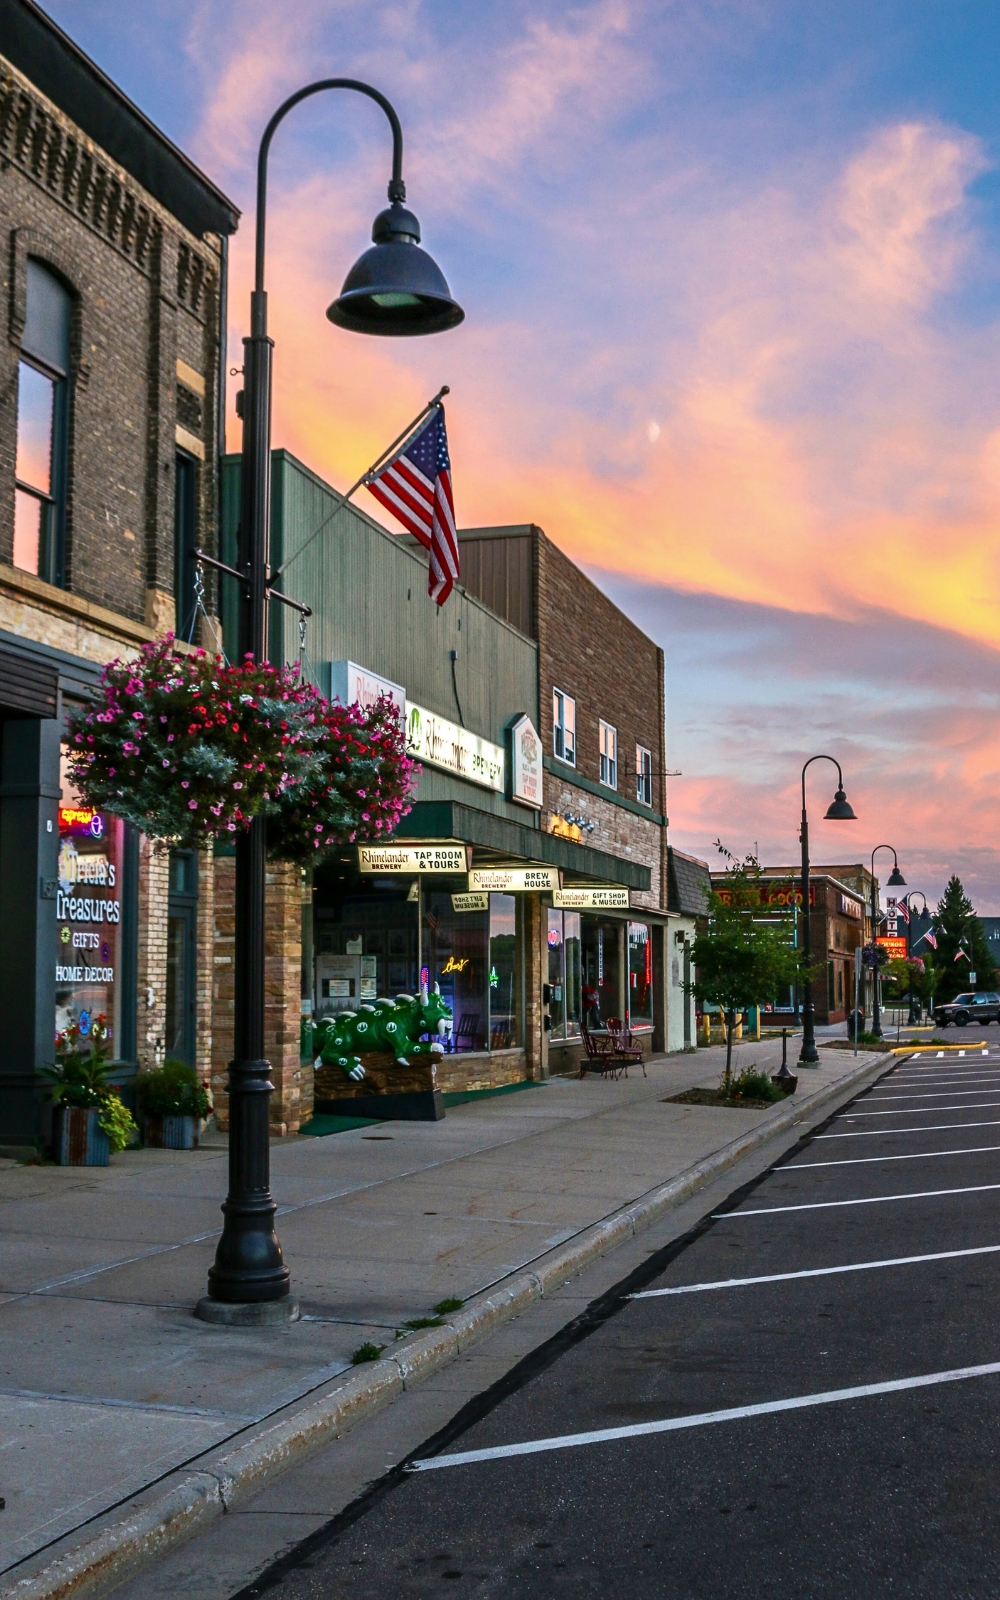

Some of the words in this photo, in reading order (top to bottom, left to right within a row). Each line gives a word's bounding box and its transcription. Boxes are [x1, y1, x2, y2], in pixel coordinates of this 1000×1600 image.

[361, 850, 410, 864] Rhinelander
[414, 851, 432, 860] TAP
[435, 851, 463, 860] ROOM
[67, 850, 116, 887] Tricia's
[419, 861, 426, 869] &
[428, 860, 460, 869] TOURS
[473, 872, 514, 885] Rhinelander
[524, 880, 551, 888] HOUSE
[555, 892, 590, 902] Rhinelander
[57, 889, 120, 923] Treasures
[72, 932, 100, 949] GIFTS
[55, 965, 83, 982] HOME
[84, 966, 114, 982] DECOR
